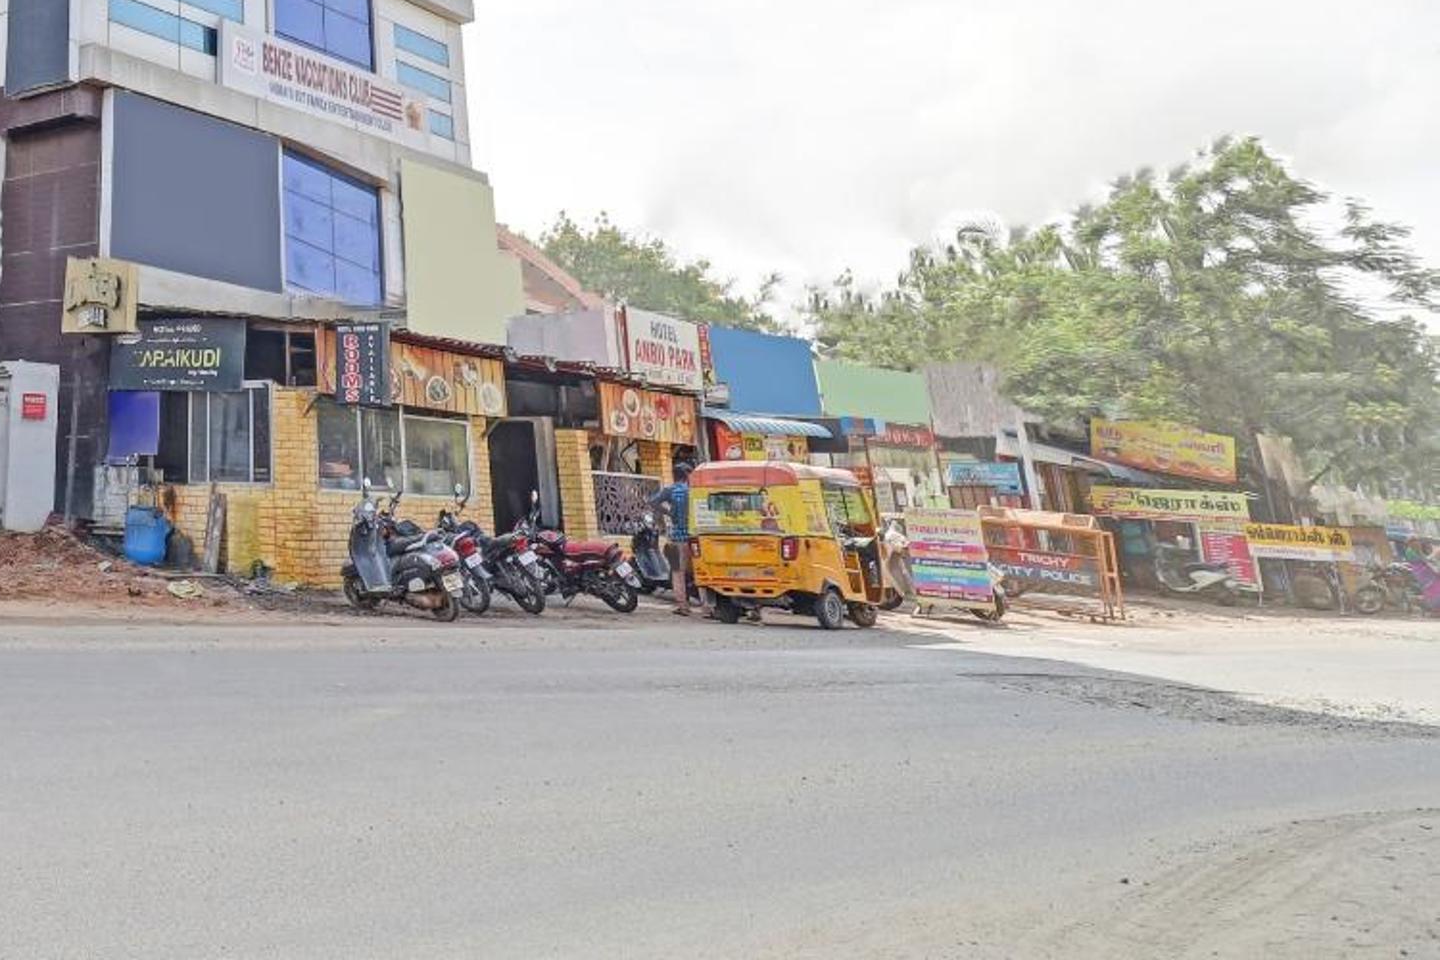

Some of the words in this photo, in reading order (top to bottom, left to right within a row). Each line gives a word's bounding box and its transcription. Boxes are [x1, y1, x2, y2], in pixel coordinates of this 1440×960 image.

[650, 321, 678, 344] HOTEL
[1017, 552, 1070, 568] TRICHY
[1001, 564, 1034, 577] CITY
[1041, 570, 1092, 586] POLICE
